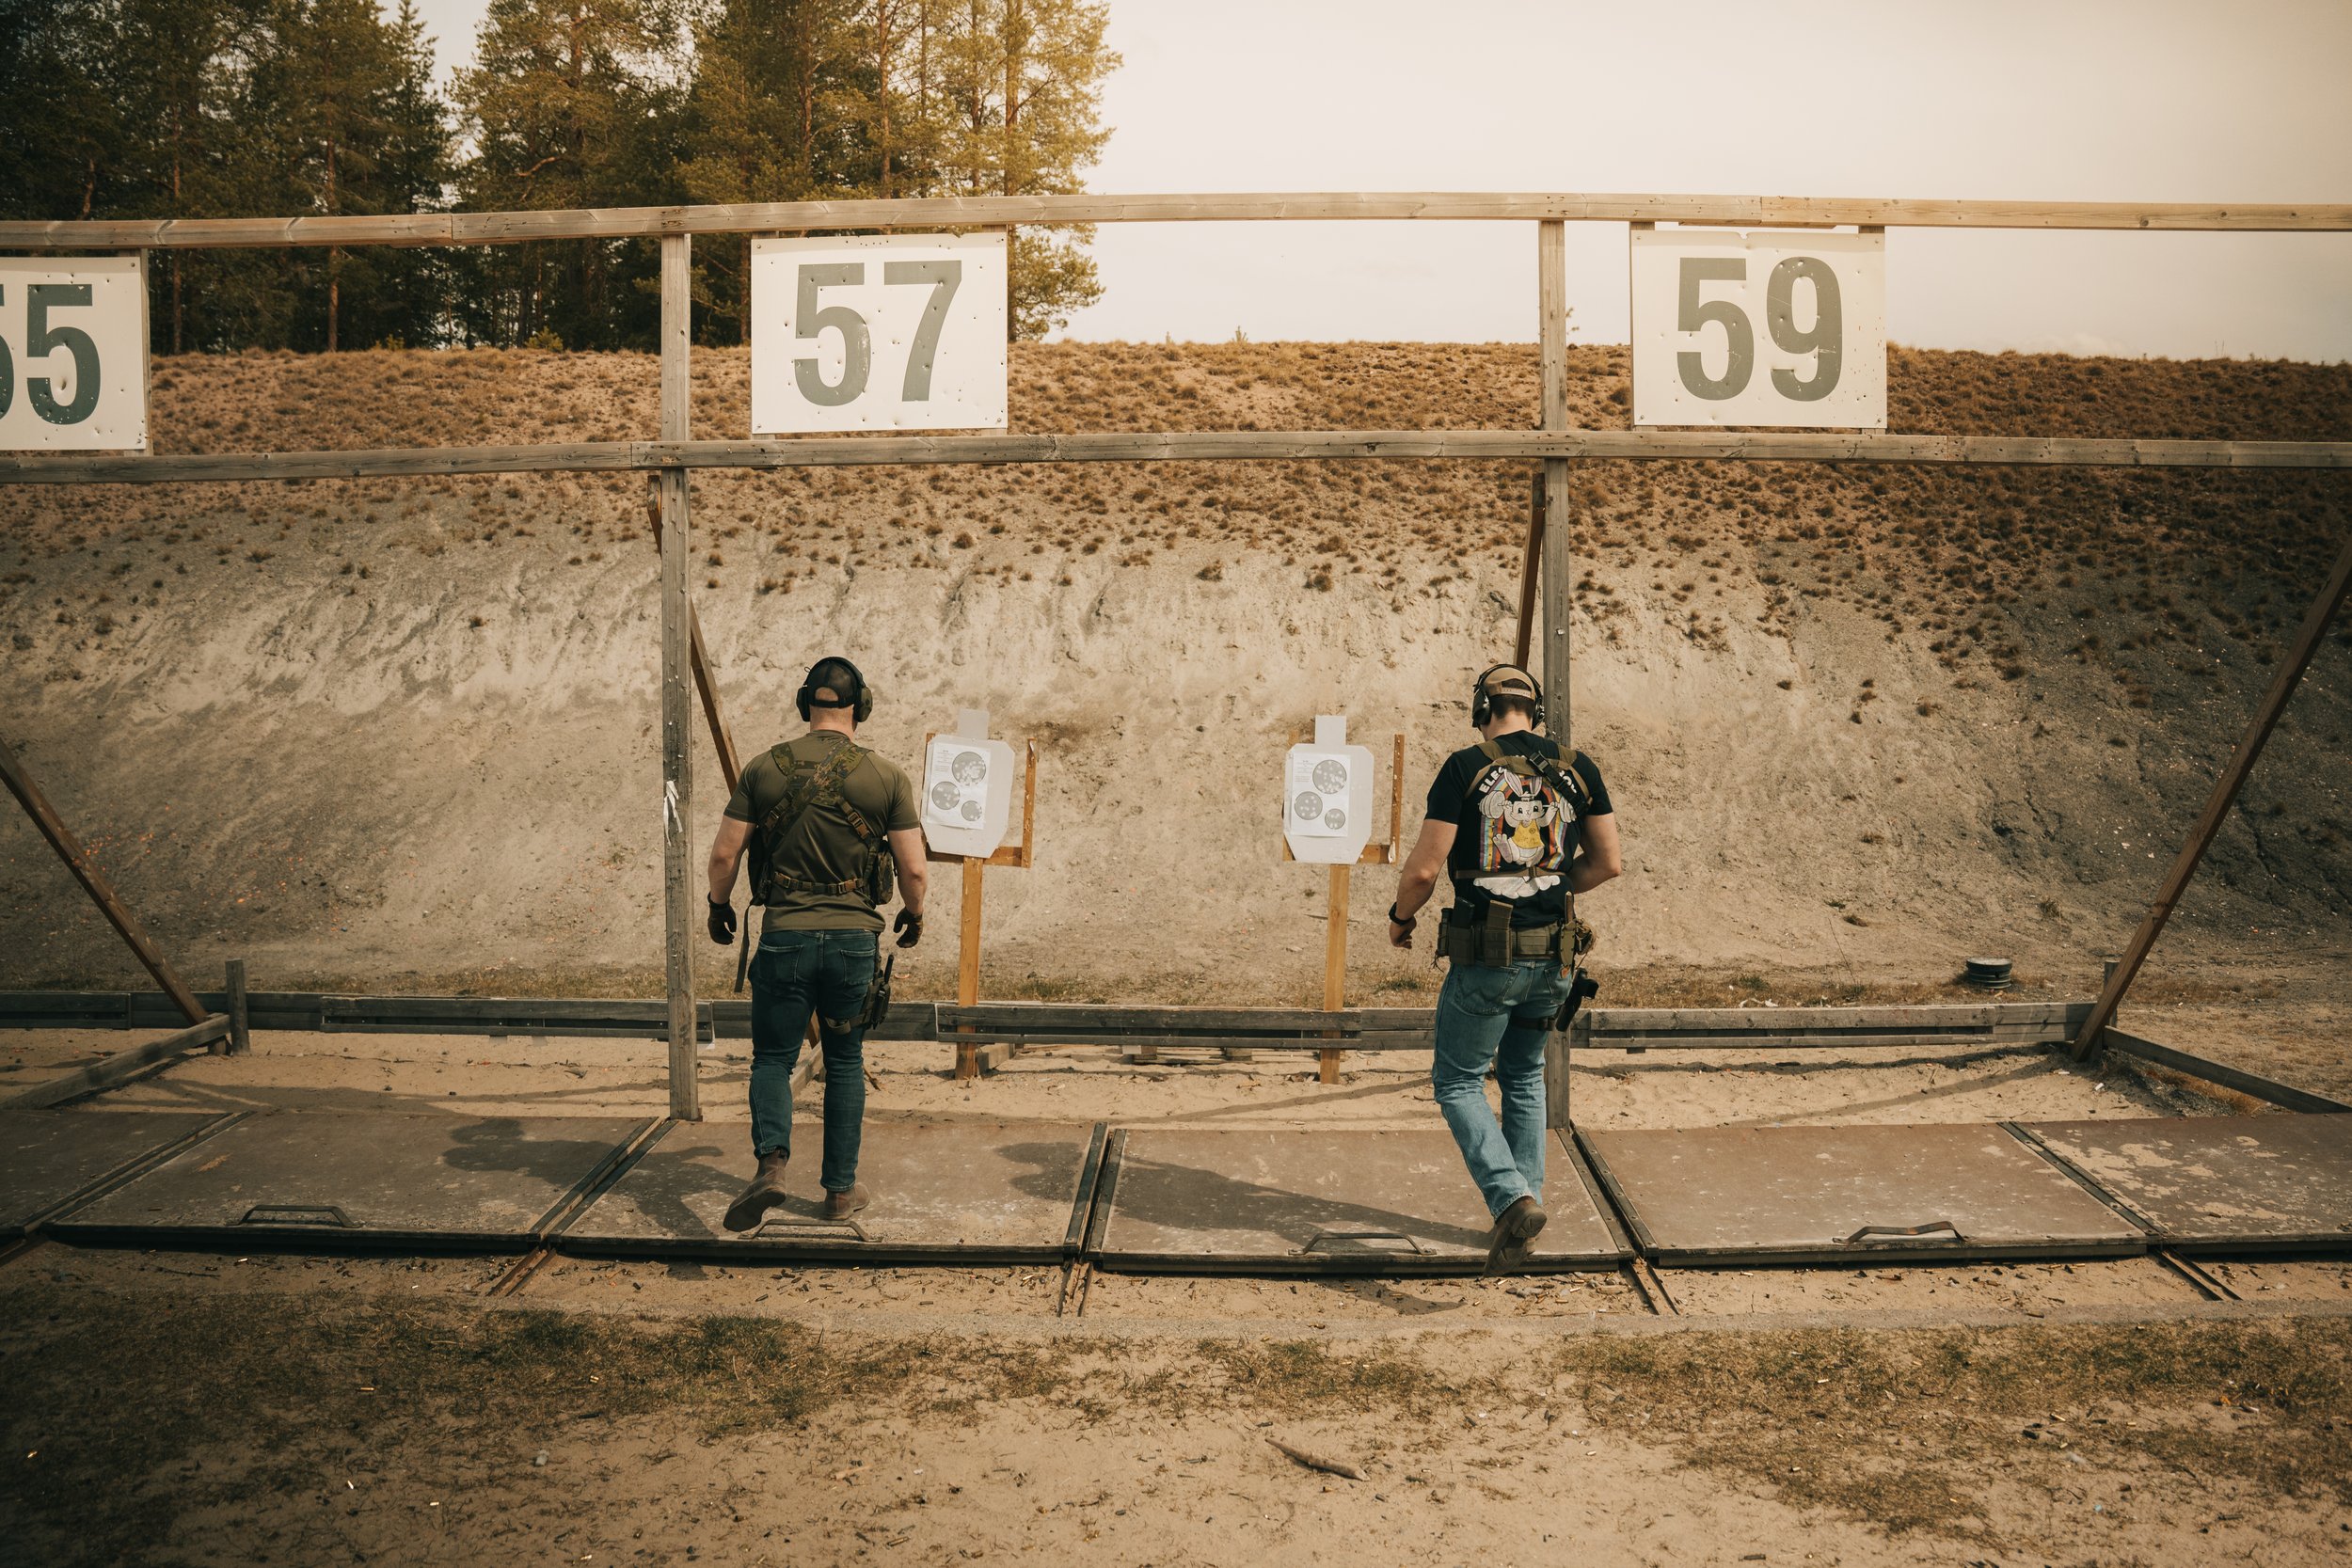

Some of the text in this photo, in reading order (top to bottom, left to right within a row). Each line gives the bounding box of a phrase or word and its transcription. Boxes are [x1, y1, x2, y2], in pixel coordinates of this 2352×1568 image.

[0, 284, 101, 424] 5
[794, 261, 961, 406] 57
[1677, 256, 1842, 402] 59
